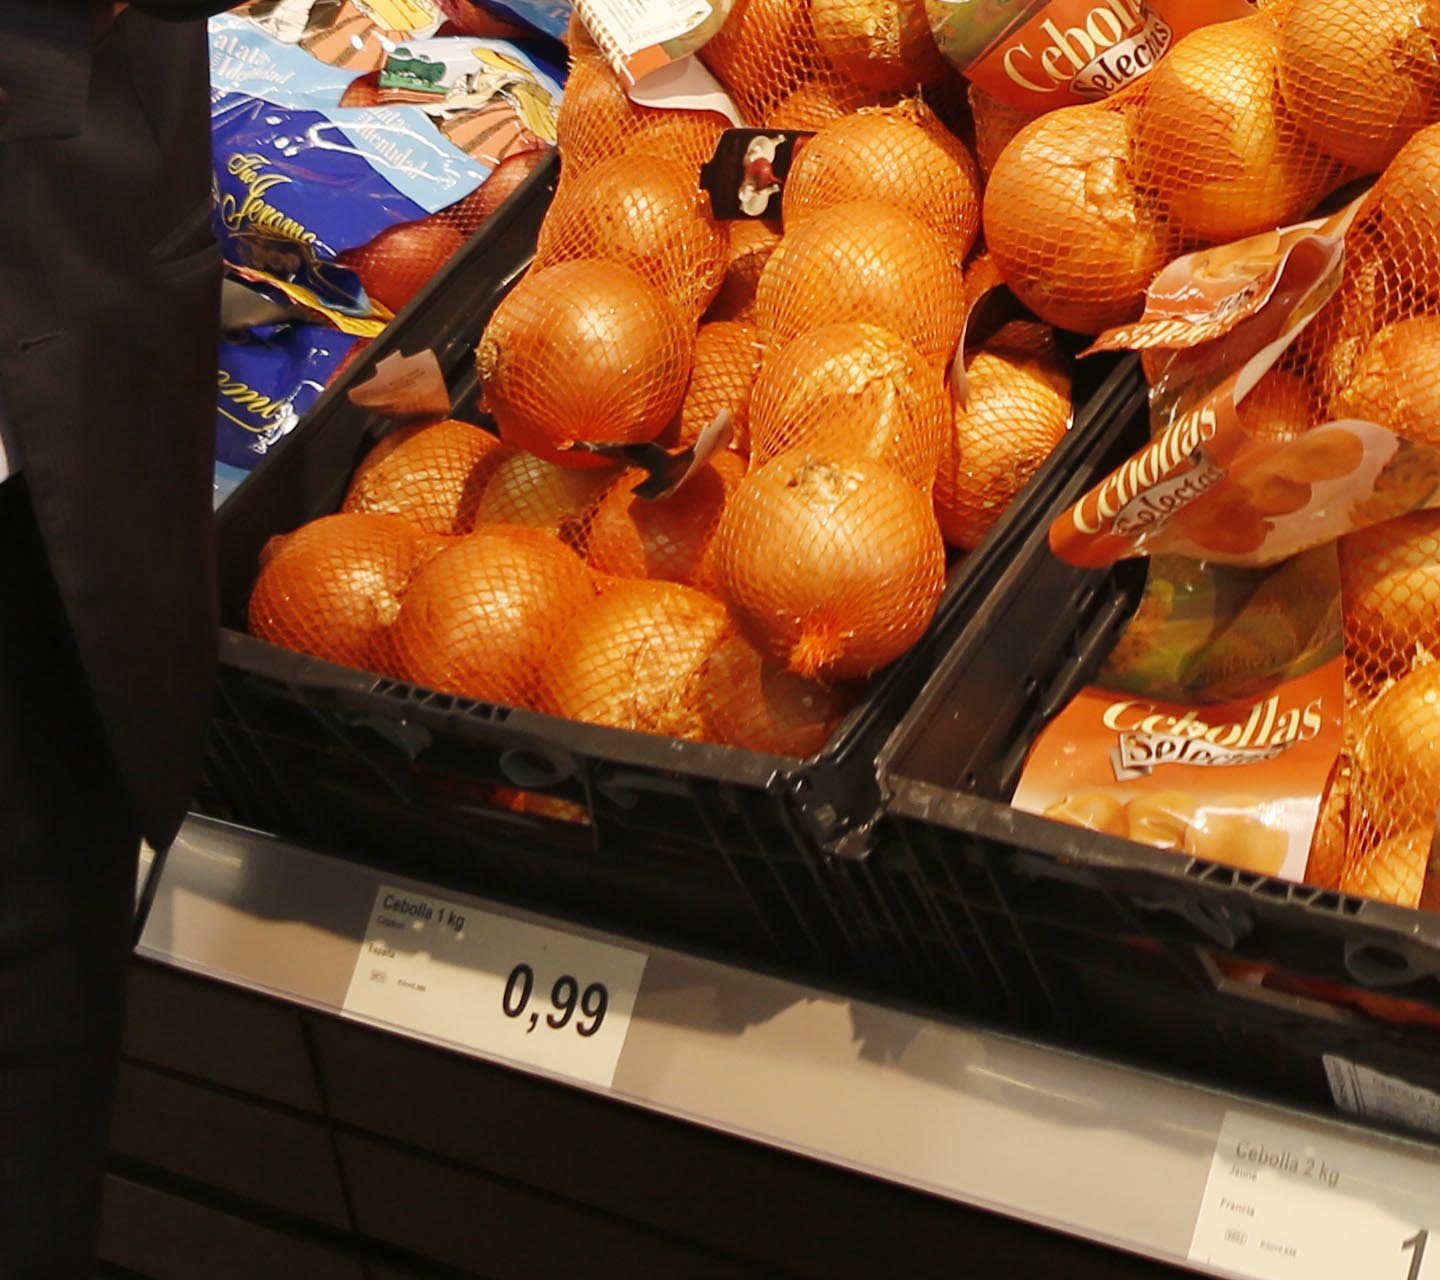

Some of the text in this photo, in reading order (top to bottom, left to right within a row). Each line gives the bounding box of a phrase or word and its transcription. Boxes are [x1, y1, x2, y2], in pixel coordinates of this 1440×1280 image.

[382, 893, 466, 933] Cebolla 1 kg
[502, 962, 609, 1038] 0,99
[1235, 1139, 1341, 1189] Cebolla 2 kg
[1220, 1196, 1257, 1218] Francia
